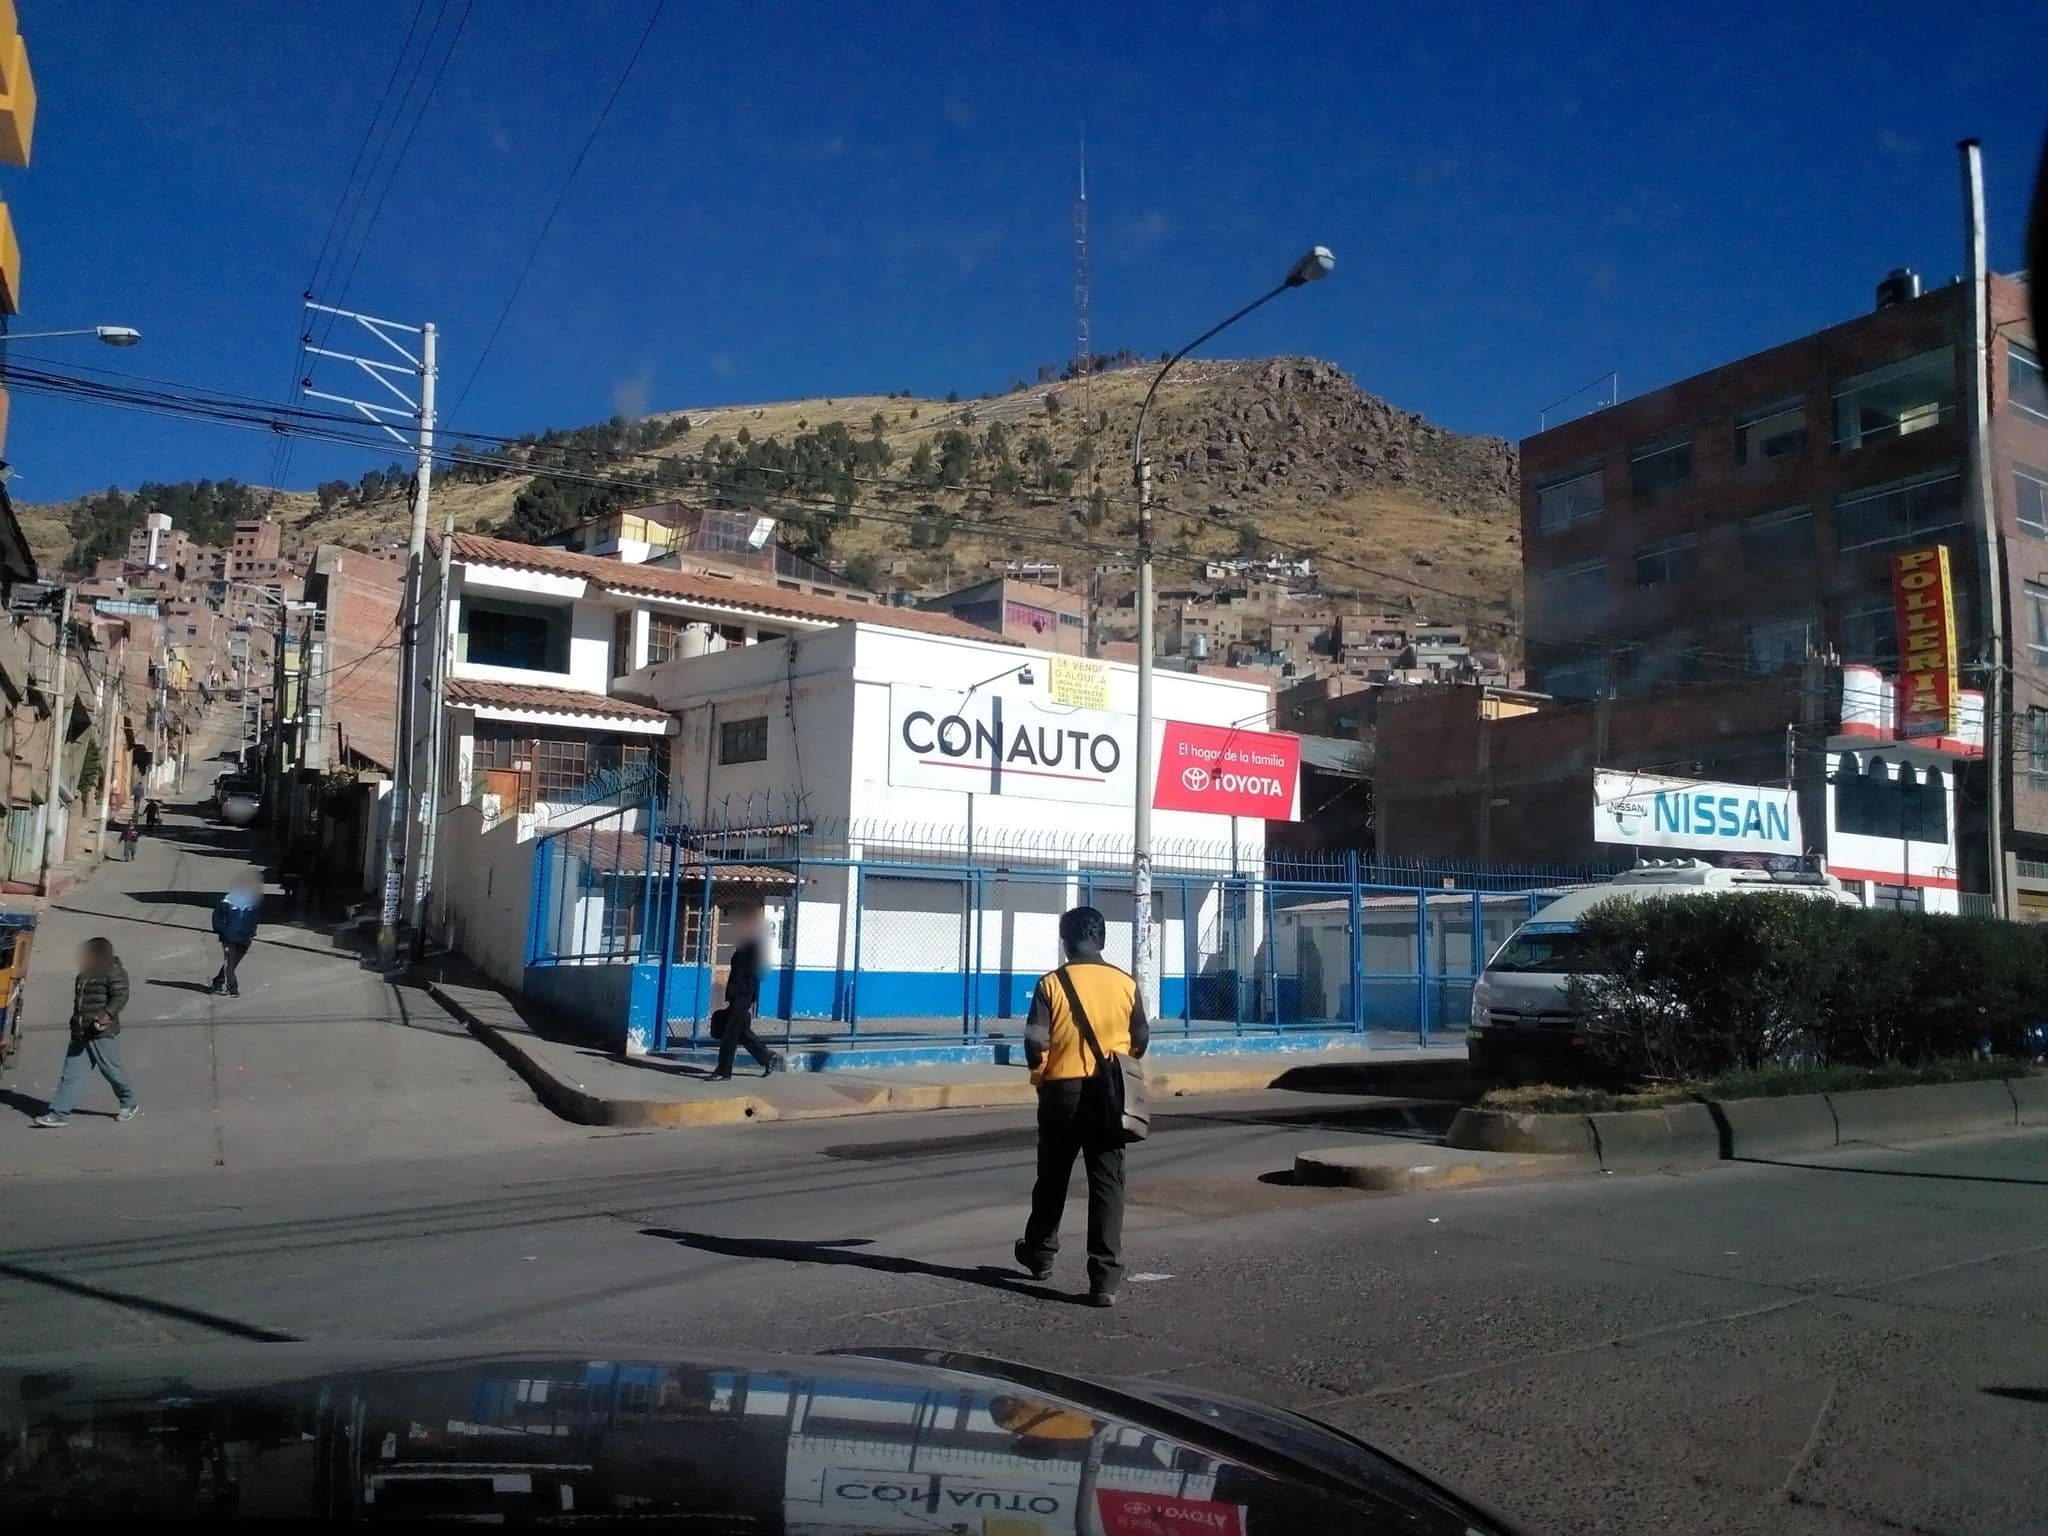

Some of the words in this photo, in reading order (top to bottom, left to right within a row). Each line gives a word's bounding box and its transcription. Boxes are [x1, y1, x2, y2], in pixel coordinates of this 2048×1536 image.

[1899, 551, 1945, 713] POLLERIA
[1055, 668, 1062, 678] O
[1065, 670, 1106, 684] ALQUIA
[1057, 659, 1069, 668] SE
[903, 711, 1120, 773] CONAUTO
[1179, 742, 1188, 756] El
[1191, 743, 1221, 761] hogar
[1224, 748, 1237, 762] de
[1240, 749, 1249, 763] la
[1251, 751, 1285, 767] familia
[1212, 772, 1282, 797] TOYOTA
[1610, 801, 1645, 813] NISSAN
[1654, 791, 1790, 841] NISSAN
